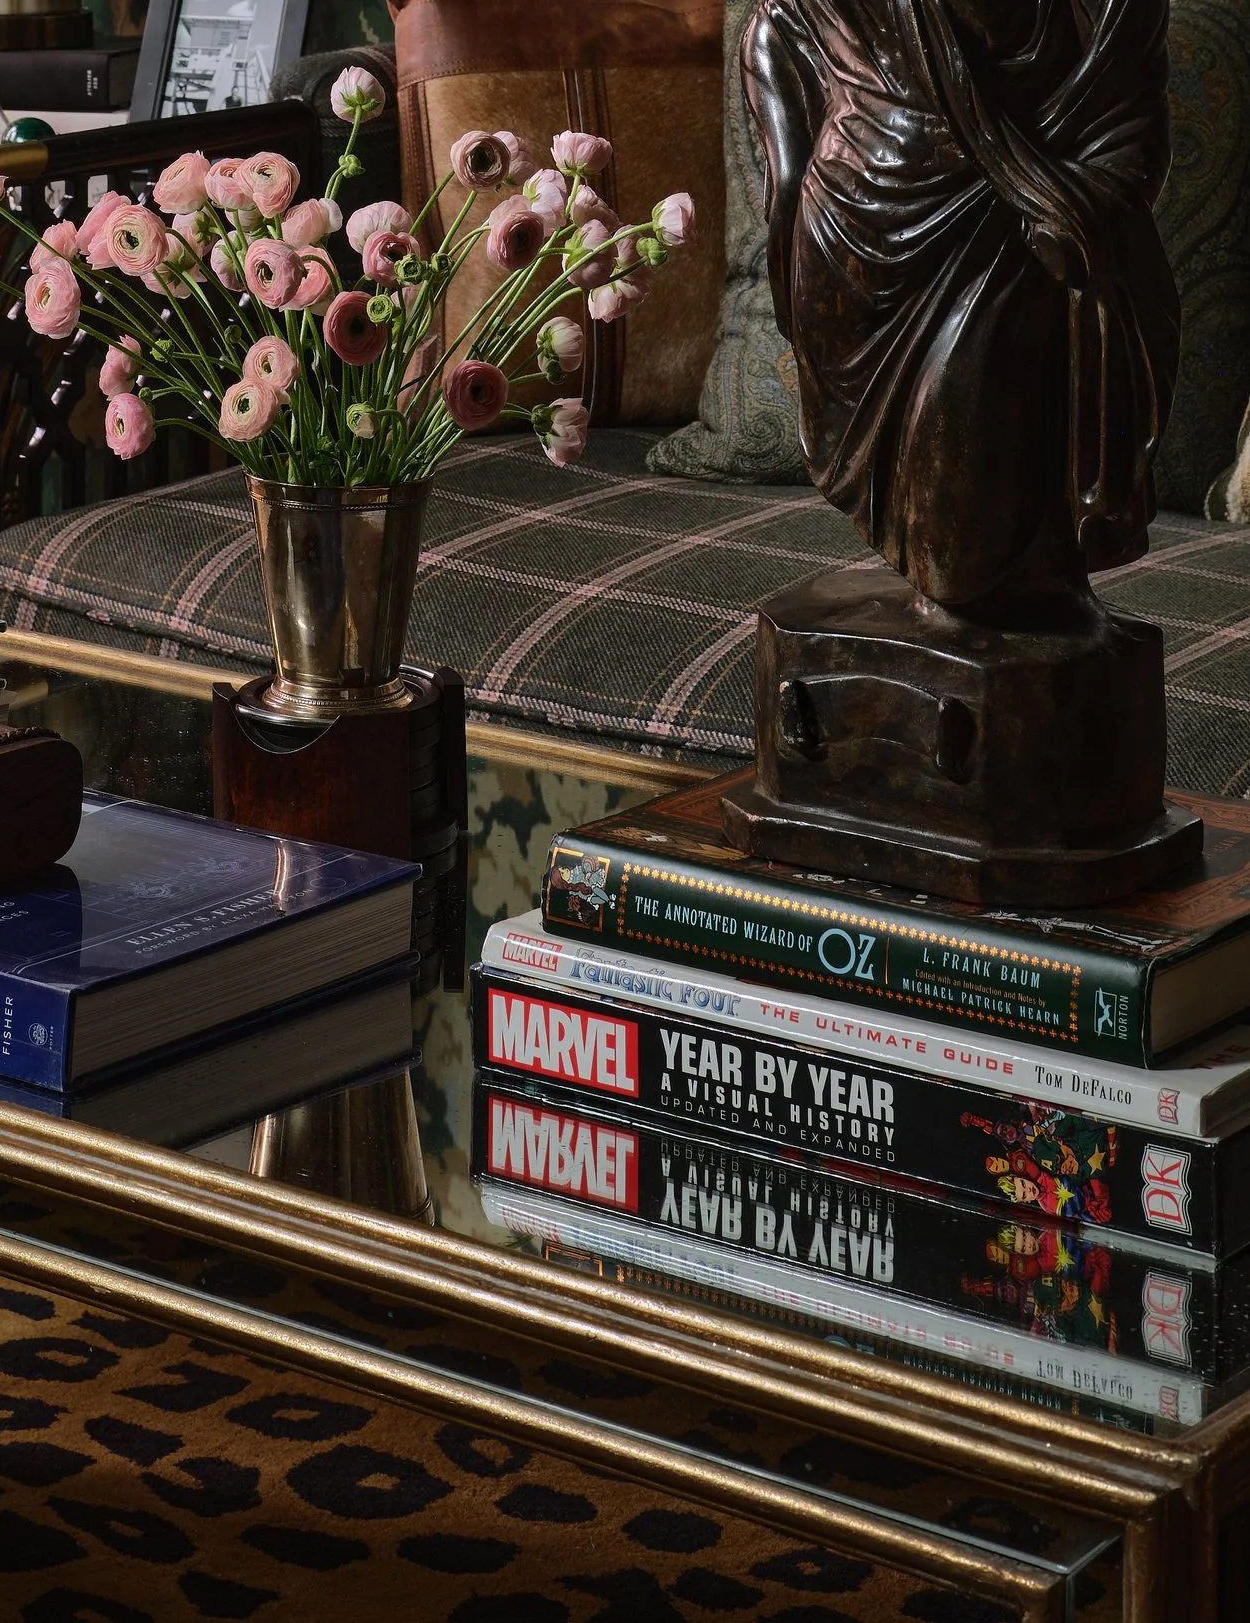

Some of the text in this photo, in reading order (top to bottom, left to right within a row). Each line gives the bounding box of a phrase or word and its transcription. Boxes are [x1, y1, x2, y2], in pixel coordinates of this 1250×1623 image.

[125, 921, 193, 946] ELLEN
[135, 930, 200, 955] FOREWORD
[503, 934, 561, 971] MARVEL
[635, 895, 876, 981] THE ANNOTATED WIZARD OF OZ
[570, 947, 674, 999] Fantastic
[915, 968, 1047, 1009] Edited with an Introduction and Notes by
[922, 947, 1041, 989] L. FRANK BAUM
[2, 996, 14, 1056] FISHER
[902, 978, 1060, 1026] MICHAEL PATRICK HEARN
[1118, 995, 1130, 1040] NORTON
[492, 994, 635, 1092] MARVEL
[760, 1003, 1014, 1076] THE ULTIMATE GUIDE
[659, 1028, 895, 1123] YEAR BY YEAR
[1035, 1065, 1132, 1105] TOM DEFALCO
[660, 1094, 896, 1163] UPDATED AND EXPANDED
[661, 1072, 895, 1146] A VISUAL HISTORY
[1158, 1089, 1179, 1123] DK
[1144, 1151, 1185, 1228] DK
